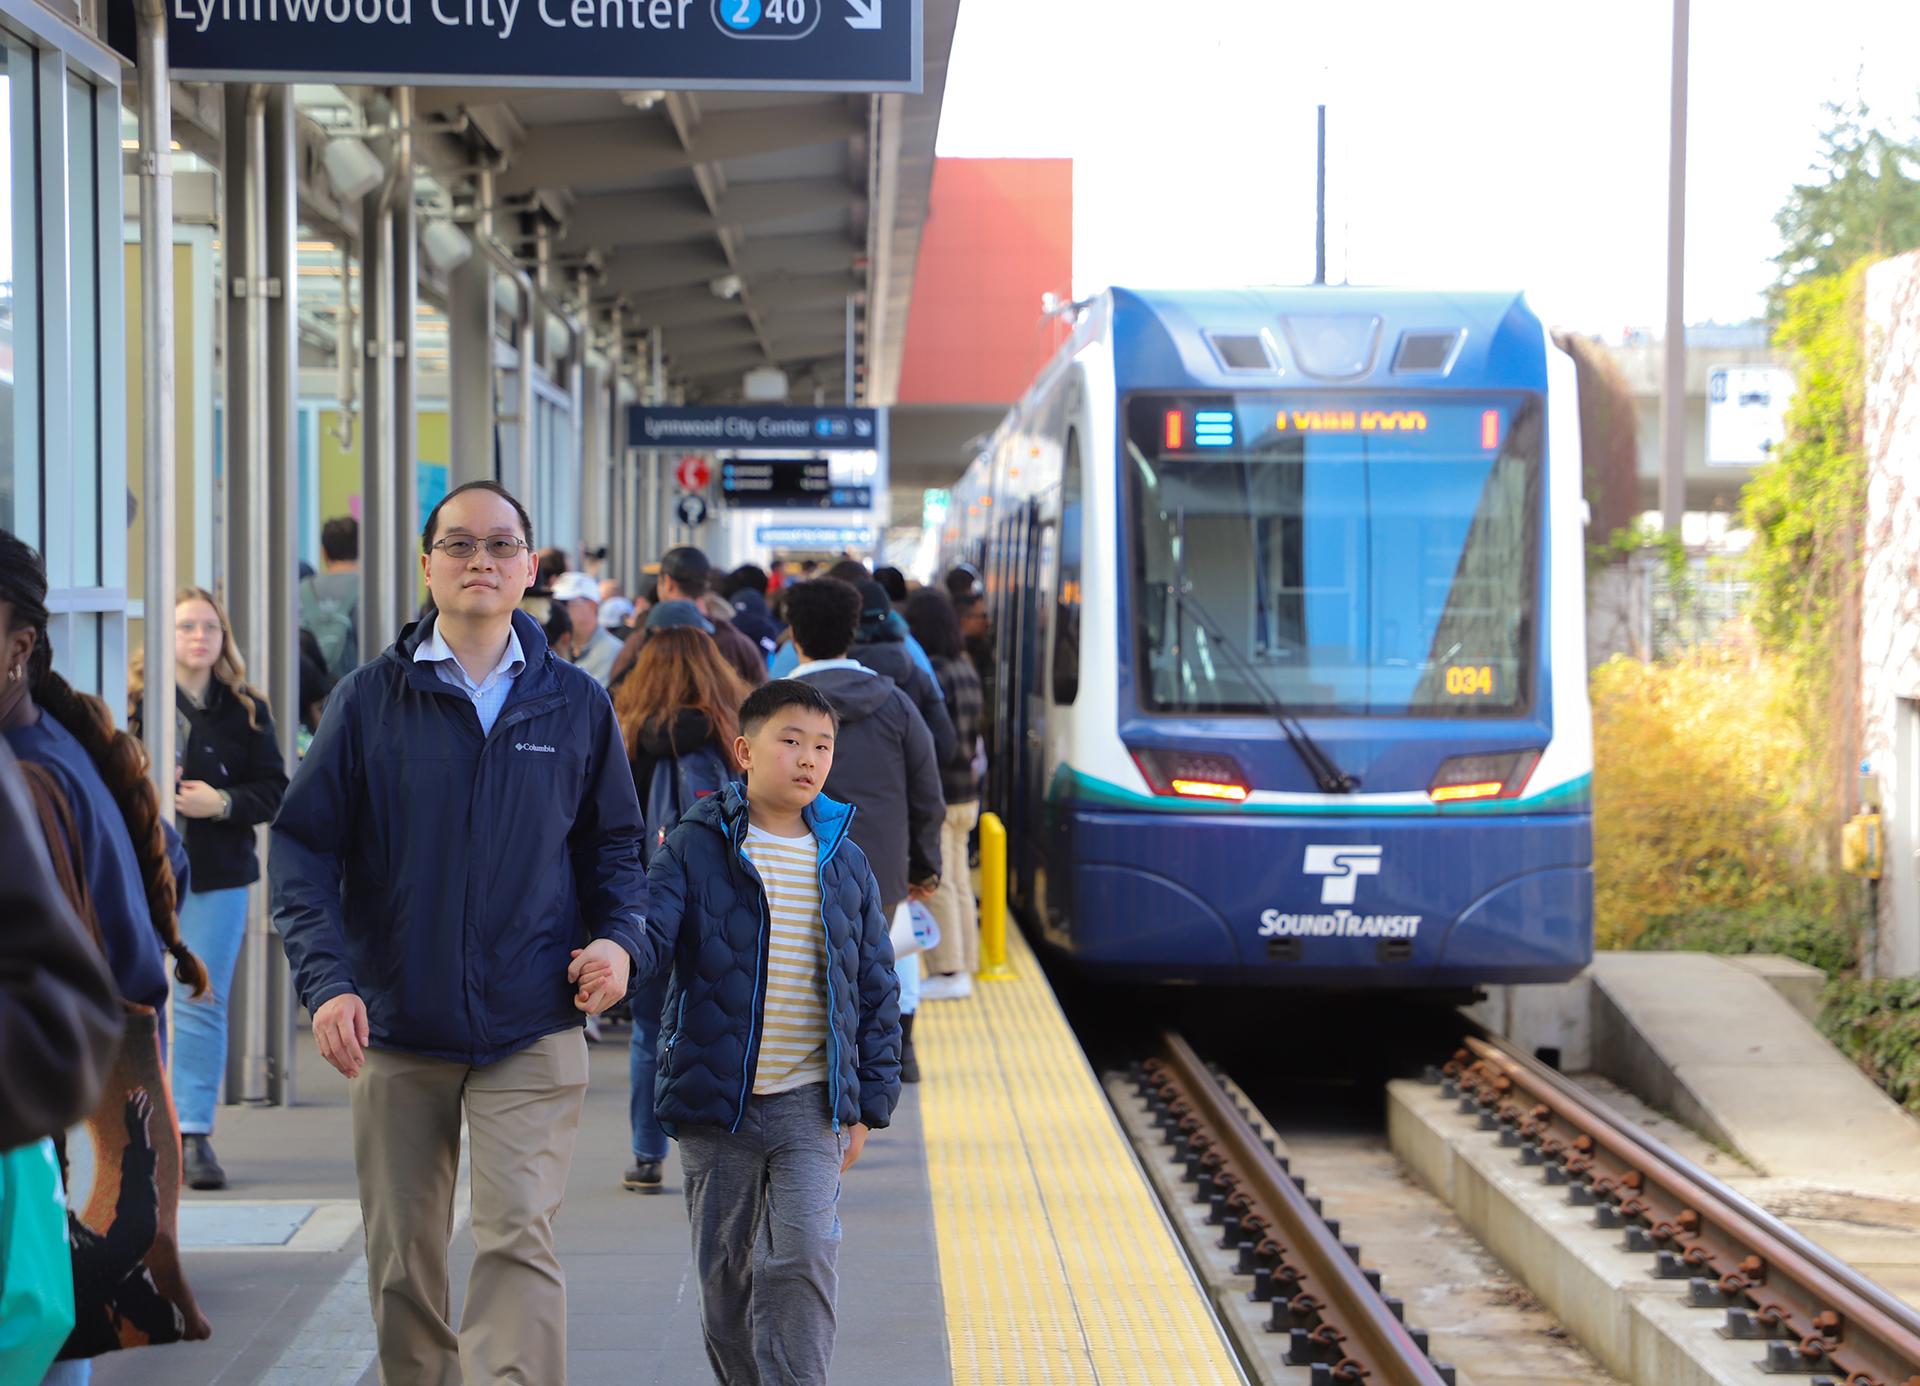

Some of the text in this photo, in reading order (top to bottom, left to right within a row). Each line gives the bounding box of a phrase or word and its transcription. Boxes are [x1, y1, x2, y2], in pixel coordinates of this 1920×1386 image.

[431, 0, 519, 39] City
[538, 0, 693, 29] Center
[731, 0, 750, 24] 2
[764, 0, 806, 25] 40
[725, 416, 756, 440] City
[1446, 666, 1492, 695] 034
[523, 743, 555, 753] Columbia
